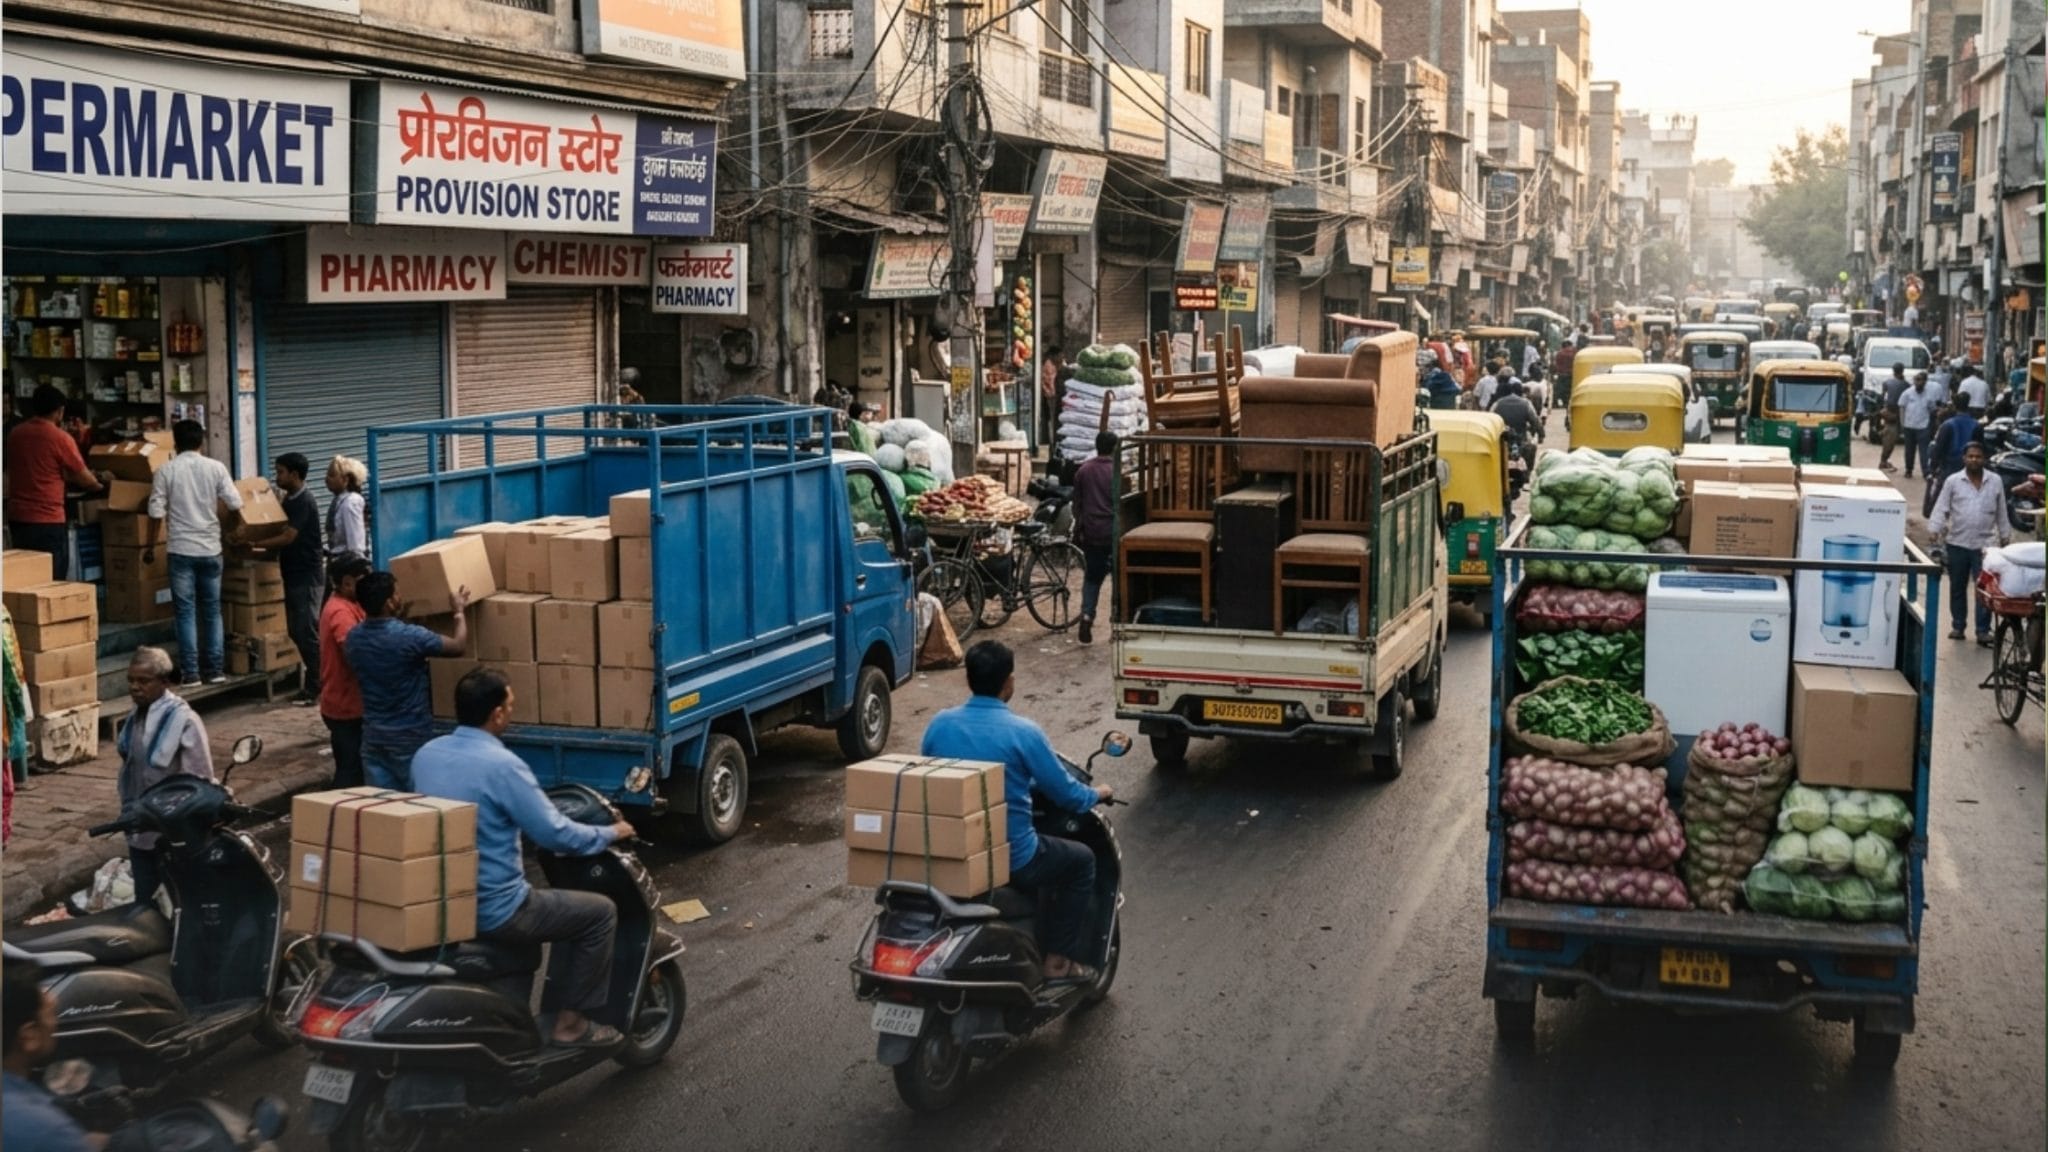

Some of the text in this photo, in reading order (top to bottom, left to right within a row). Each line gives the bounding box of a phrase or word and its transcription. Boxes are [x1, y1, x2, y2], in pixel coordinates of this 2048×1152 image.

[558, 113, 622, 175] स्टोर
[397, 175, 620, 222] PROVISION STORE
[320, 253, 497, 293] PHARMACY
[513, 238, 647, 278] CHEMIST
[656, 285, 735, 308] PHARMACY
